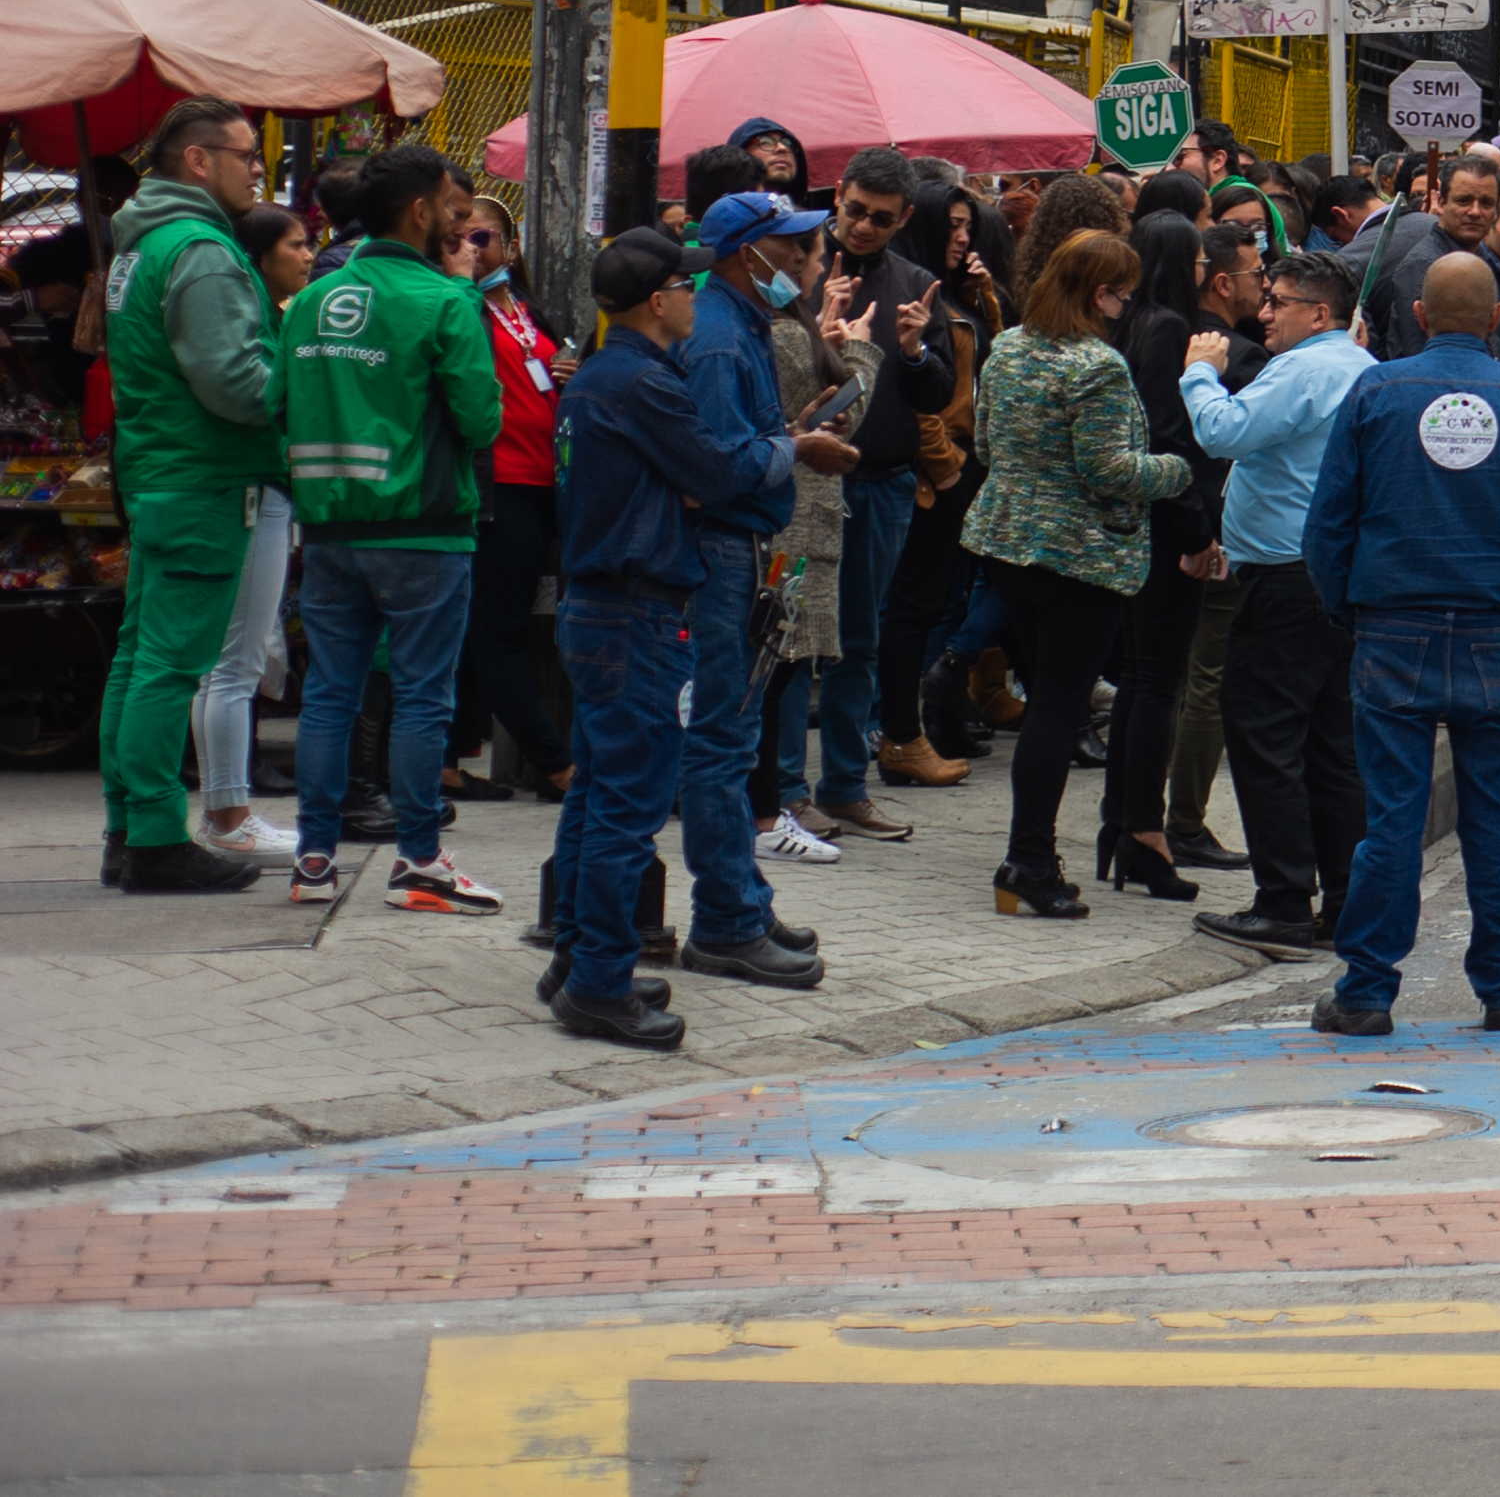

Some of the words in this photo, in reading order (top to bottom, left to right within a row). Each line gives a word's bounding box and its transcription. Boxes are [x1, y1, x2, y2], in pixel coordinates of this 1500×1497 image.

[1097, 78, 1187, 100] SEMISOTANO
[1413, 80, 1460, 97] SEMI
[1115, 93, 1177, 141] SIGA
[1394, 110, 1476, 129] SOTANO
[295, 342, 385, 367] serientrega
